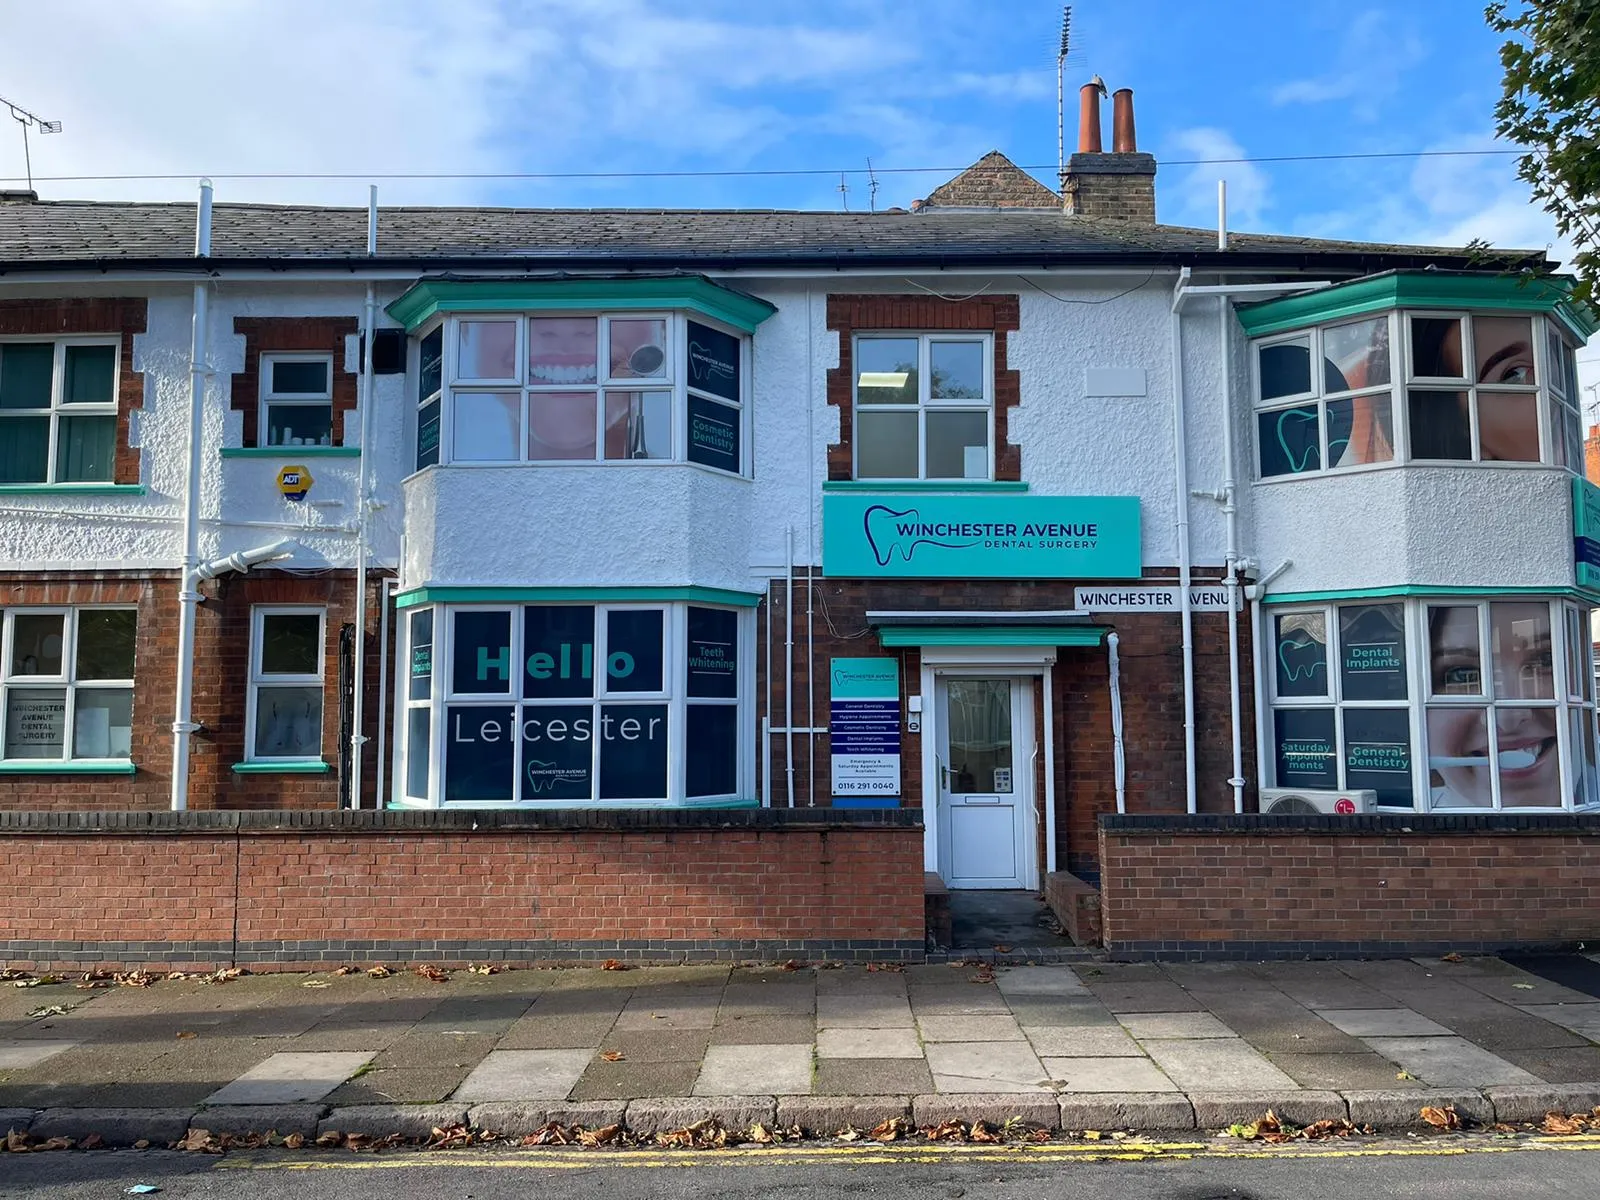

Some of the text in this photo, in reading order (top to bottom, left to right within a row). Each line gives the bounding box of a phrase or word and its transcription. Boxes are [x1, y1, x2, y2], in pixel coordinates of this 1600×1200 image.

[693, 420, 734, 439] Cosmetic
[693, 430, 734, 451] Dentistry
[283, 475, 300, 484] ADT
[896, 522, 1099, 538] WINCHESTER AVENUE
[983, 540, 1099, 549] DENTAL SURGERY
[1080, 592, 1239, 606] WINCHESTER VENU
[700, 646, 724, 657] Teeth
[1352, 647, 1393, 658] Dental
[477, 643, 635, 681] Hello
[689, 657, 735, 671] Whitening
[1346, 658, 1400, 669] Implants
[455, 711, 661, 743] Leicester
[1281, 743, 1331, 753] Saturday
[1352, 747, 1403, 757] General
[1289, 761, 1325, 770] ments
[1348, 757, 1409, 769] Dentistry
